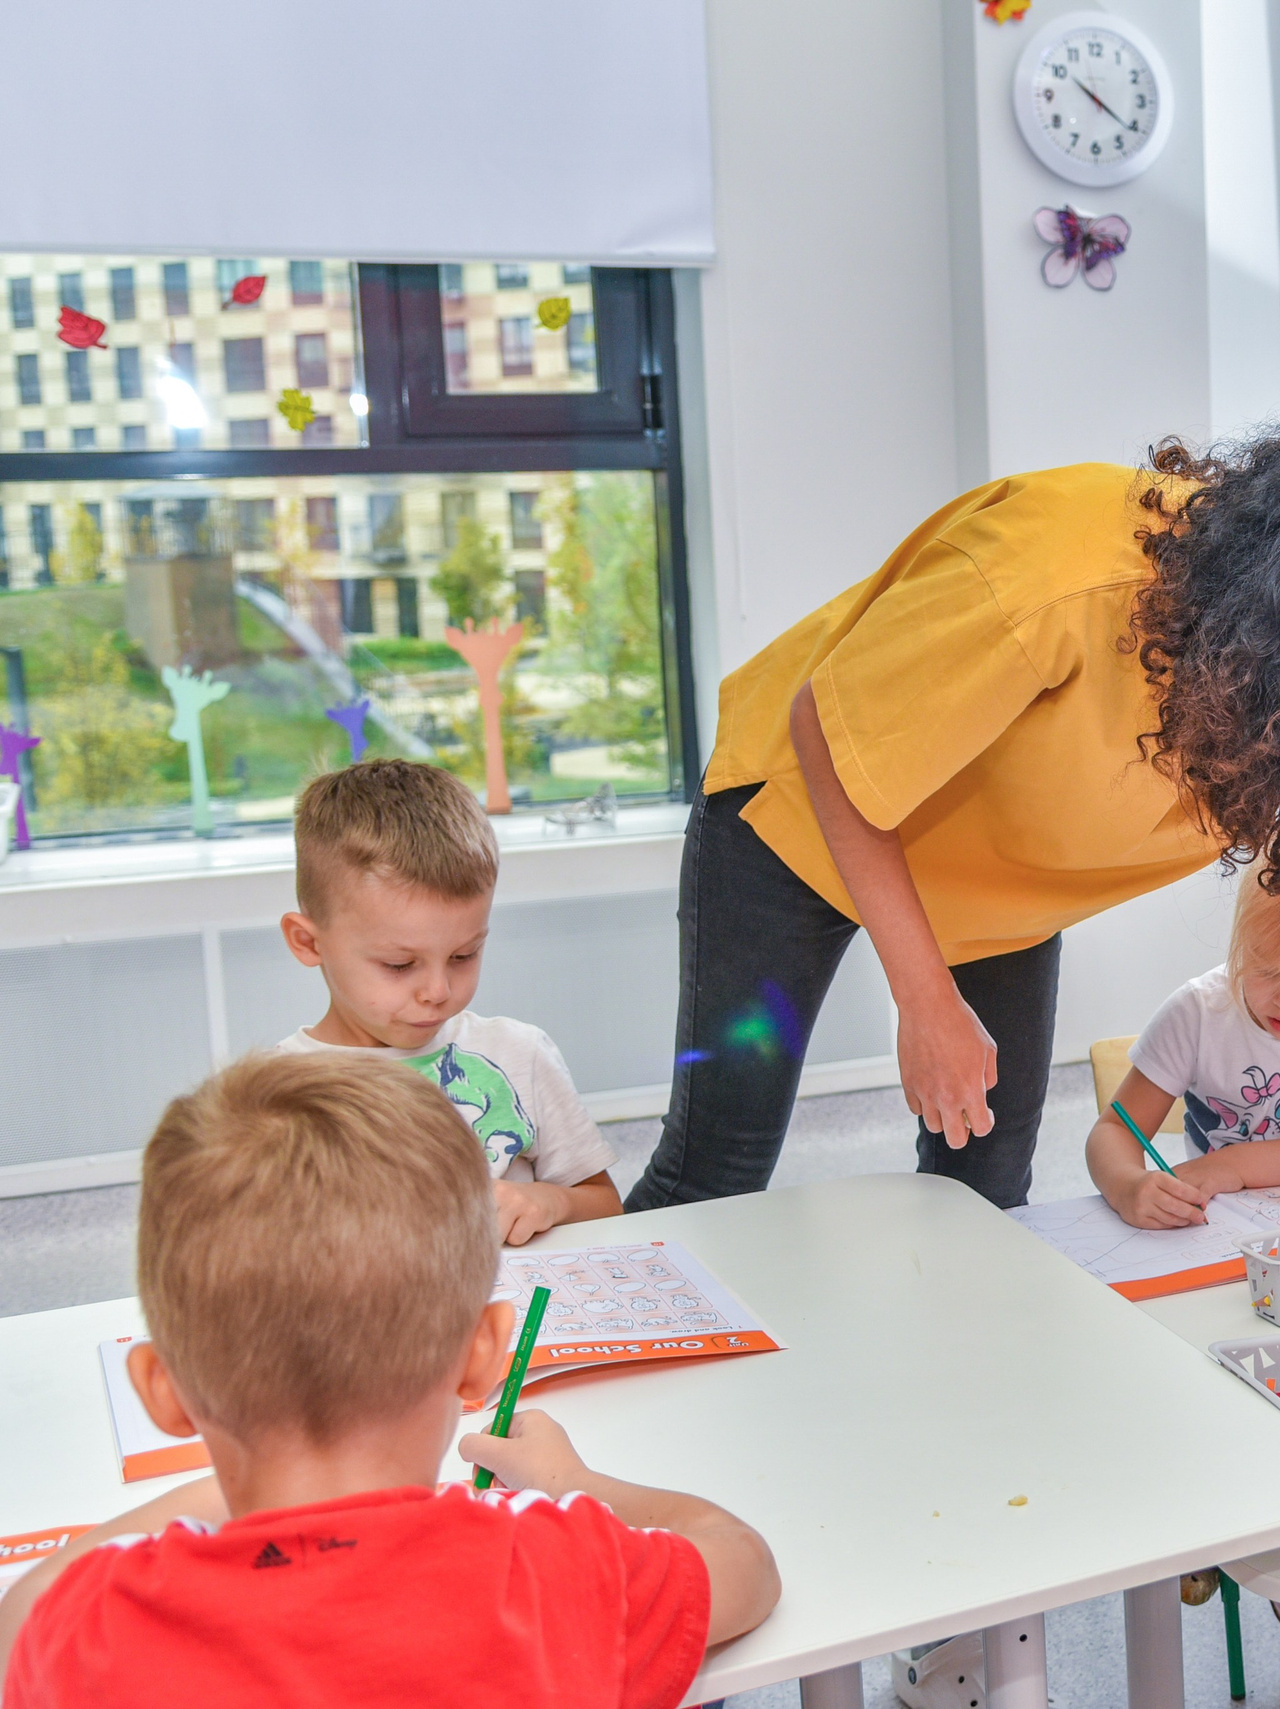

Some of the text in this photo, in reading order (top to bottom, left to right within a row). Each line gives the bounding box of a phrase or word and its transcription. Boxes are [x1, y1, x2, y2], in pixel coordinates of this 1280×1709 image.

[1067, 48, 1079, 62] 11
[1087, 42, 1103, 58] 12
[1114, 51, 1121, 65] 1
[1051, 65, 1067, 79] 10
[1129, 70, 1139, 84] 2
[1044, 88, 1054, 103] 9
[1136, 94, 1147, 109] 3
[1052, 114, 1061, 129] 8
[1129, 119, 1139, 132] 4
[1070, 132, 1080, 147] 7
[1114, 134, 1124, 150] 5
[1090, 140, 1101, 155] 6
[727, 1336, 741, 1344] 2
[550, 1340, 705, 1358] Our School
